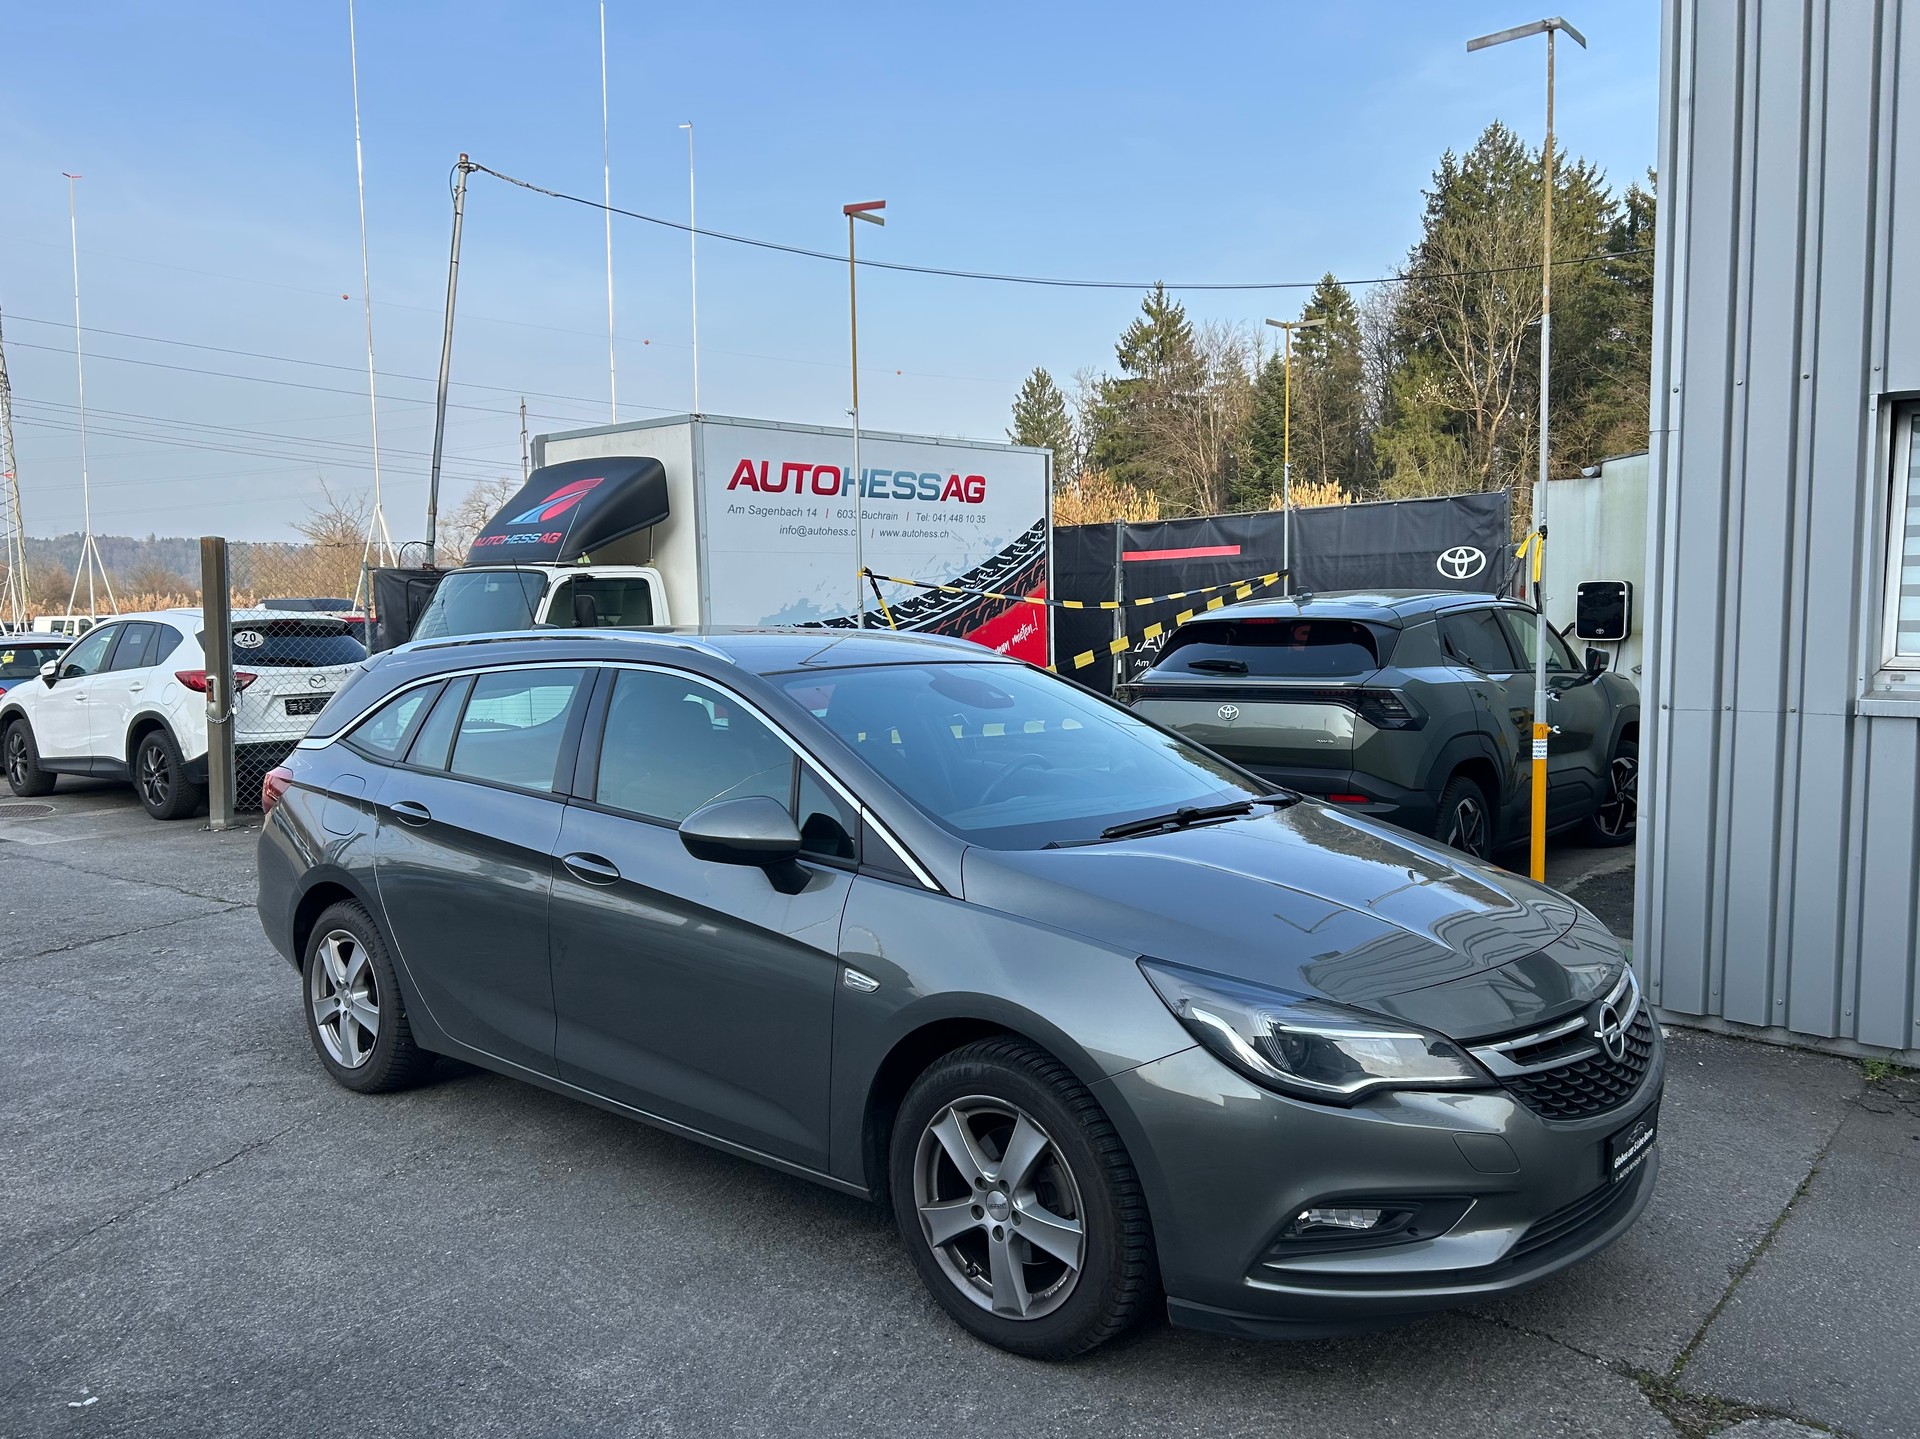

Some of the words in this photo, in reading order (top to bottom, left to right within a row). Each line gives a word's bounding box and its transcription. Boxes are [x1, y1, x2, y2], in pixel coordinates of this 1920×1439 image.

[727, 504, 745, 515] Am
[748, 504, 803, 518] Sagenbach
[806, 508, 817, 518] 14
[861, 510, 899, 521] Buchrain
[916, 512, 930, 522] Tel:
[932, 513, 947, 522] 041
[949, 513, 964, 523] 448
[966, 514, 975, 523] 10
[976, 514, 986, 524] 35
[779, 525, 858, 537] info@autohess.c
[879, 529, 949, 538] www.autohess.ch
[241, 632, 256, 643] 20
[1134, 658, 1150, 667] Am
